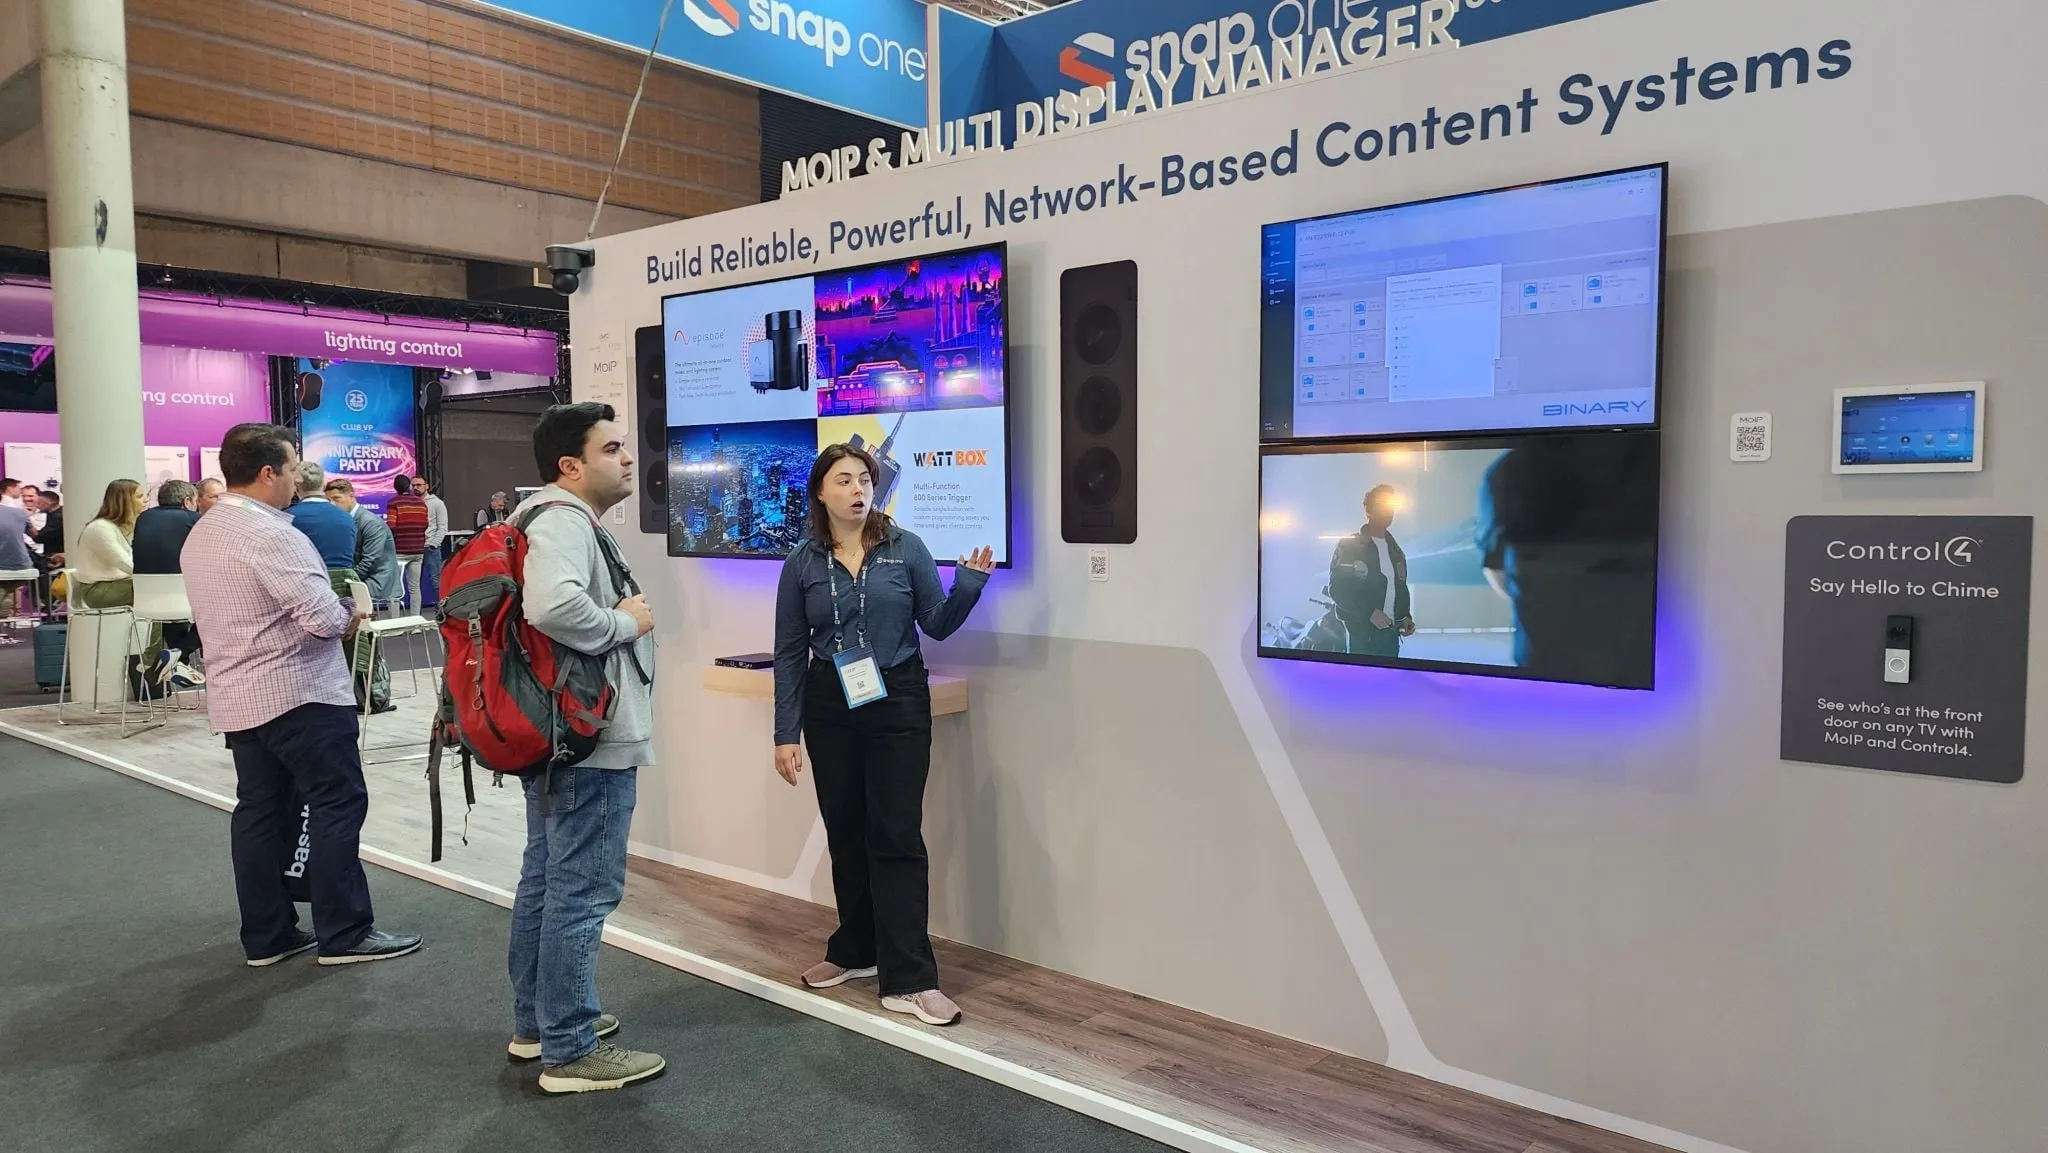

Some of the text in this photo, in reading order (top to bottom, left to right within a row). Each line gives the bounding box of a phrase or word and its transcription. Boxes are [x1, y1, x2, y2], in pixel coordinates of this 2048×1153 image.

[749, 0, 926, 82] snap one
[1125, 12, 1256, 80] snap
[780, 0, 1460, 198] MOIP & MULTI DISPLAY MANAGER
[647, 39, 1852, 284] Build Reliable, Powerful, Network-Based Content Systems
[324, 331, 462, 357] lighting control
[142, 390, 235, 406] ng control
[1543, 400, 1647, 416] BINARY
[339, 459, 381, 472] PARTY
[1810, 577, 1999, 599] Say Hello to Chime
[1817, 698, 1844, 711] See
[1895, 705, 1911, 716] at
[1915, 706, 1940, 719] the
[1944, 707, 1984, 723] front
[1824, 716, 1974, 739] door on any TV with
[1825, 732, 1972, 757] MoIP and Control4.
